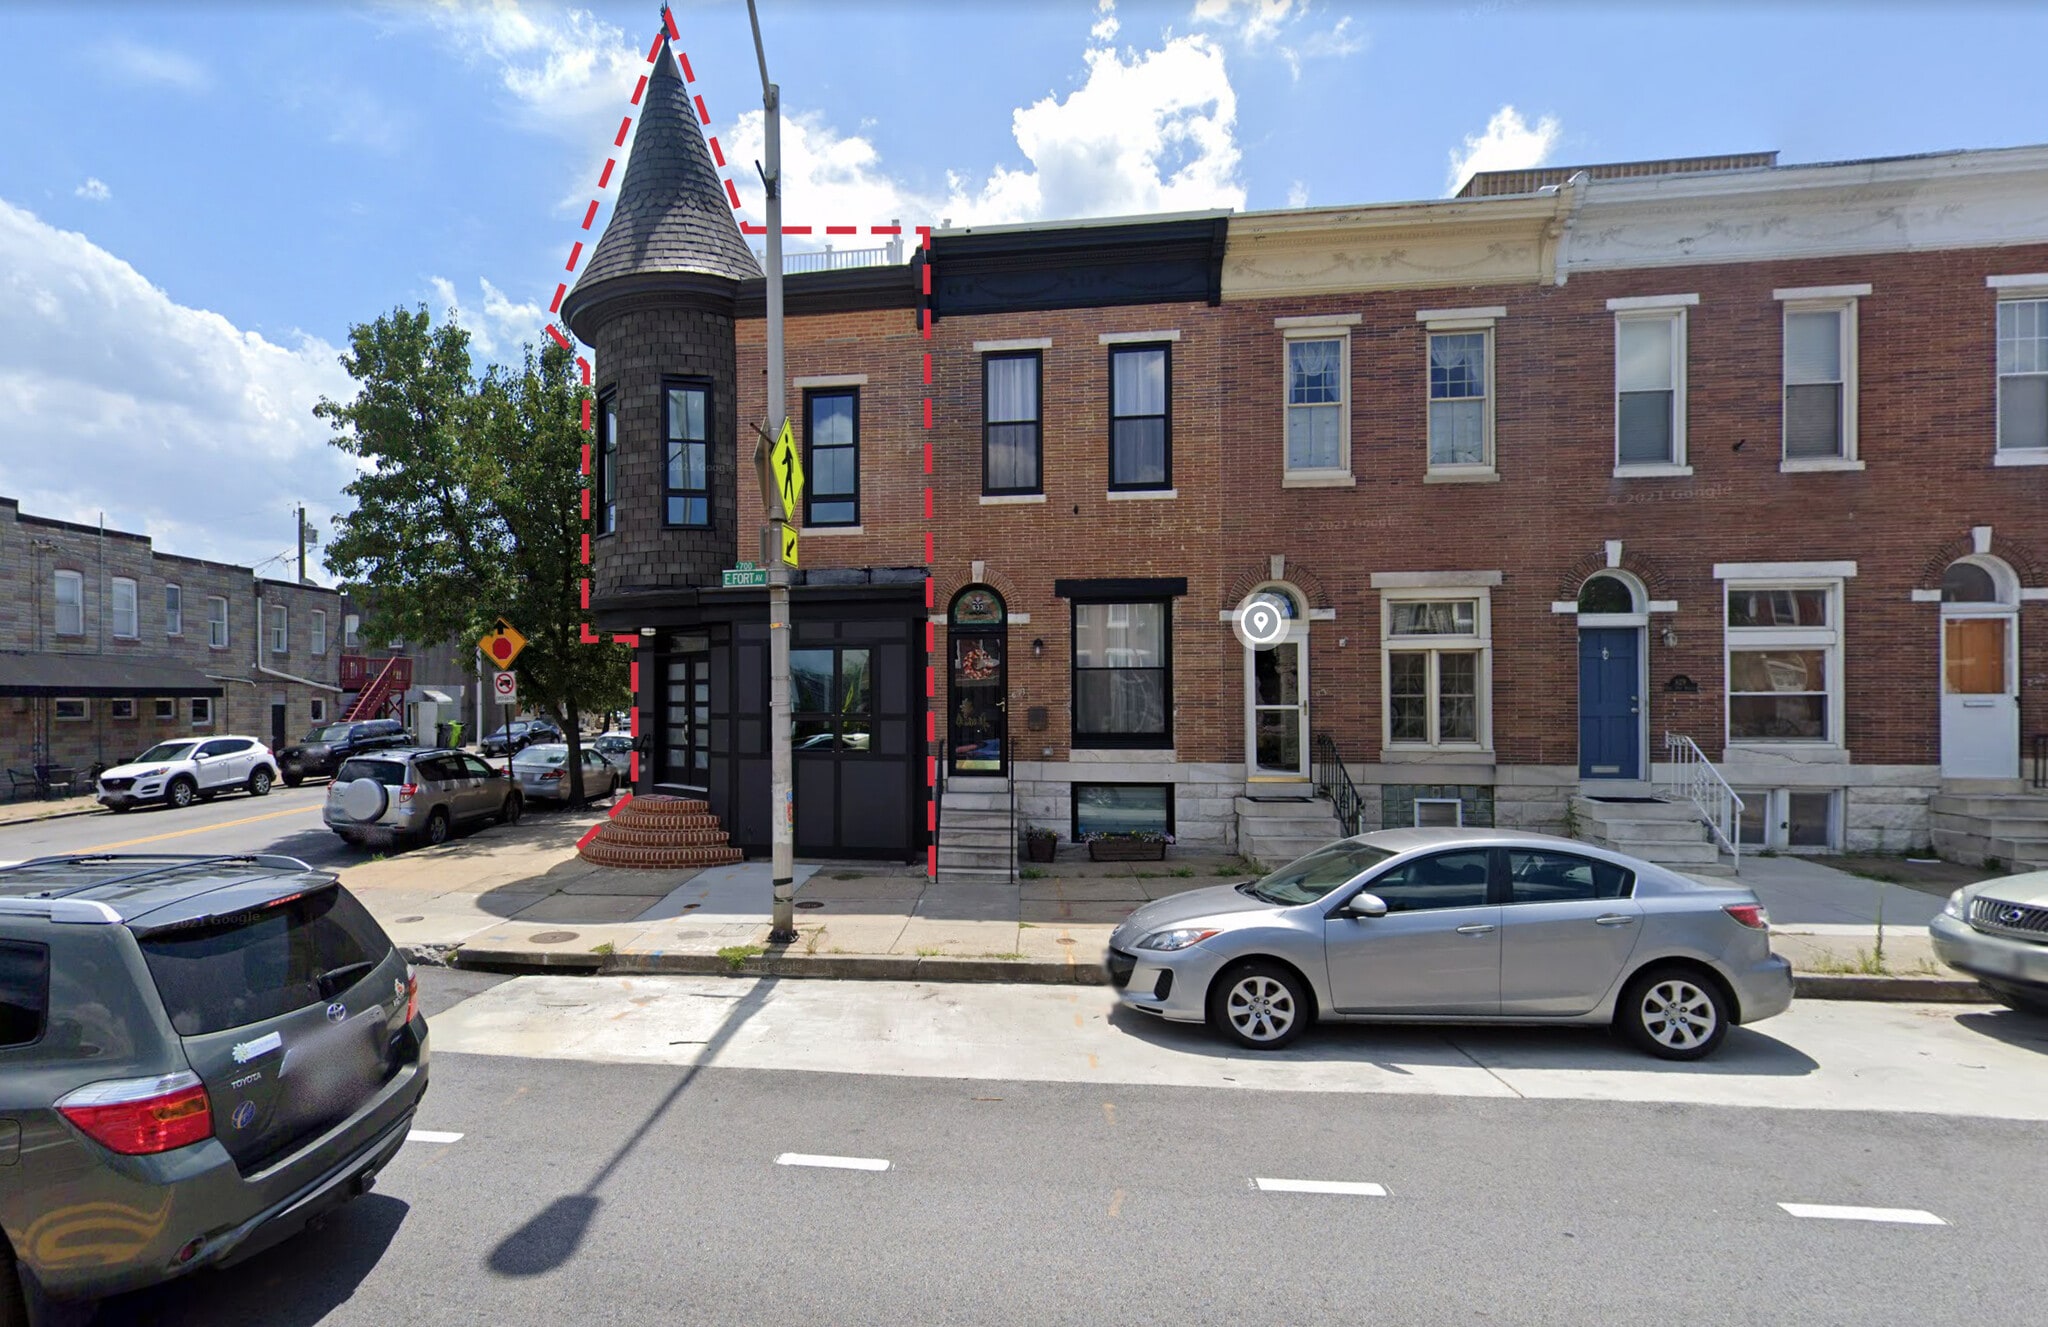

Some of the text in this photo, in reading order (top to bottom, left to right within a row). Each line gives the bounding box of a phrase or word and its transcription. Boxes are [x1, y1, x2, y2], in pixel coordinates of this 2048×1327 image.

[739, 562, 753, 571] 700
[725, 572, 763, 585] E FORT AV
[231, 1072, 262, 1089] TOYOTA
